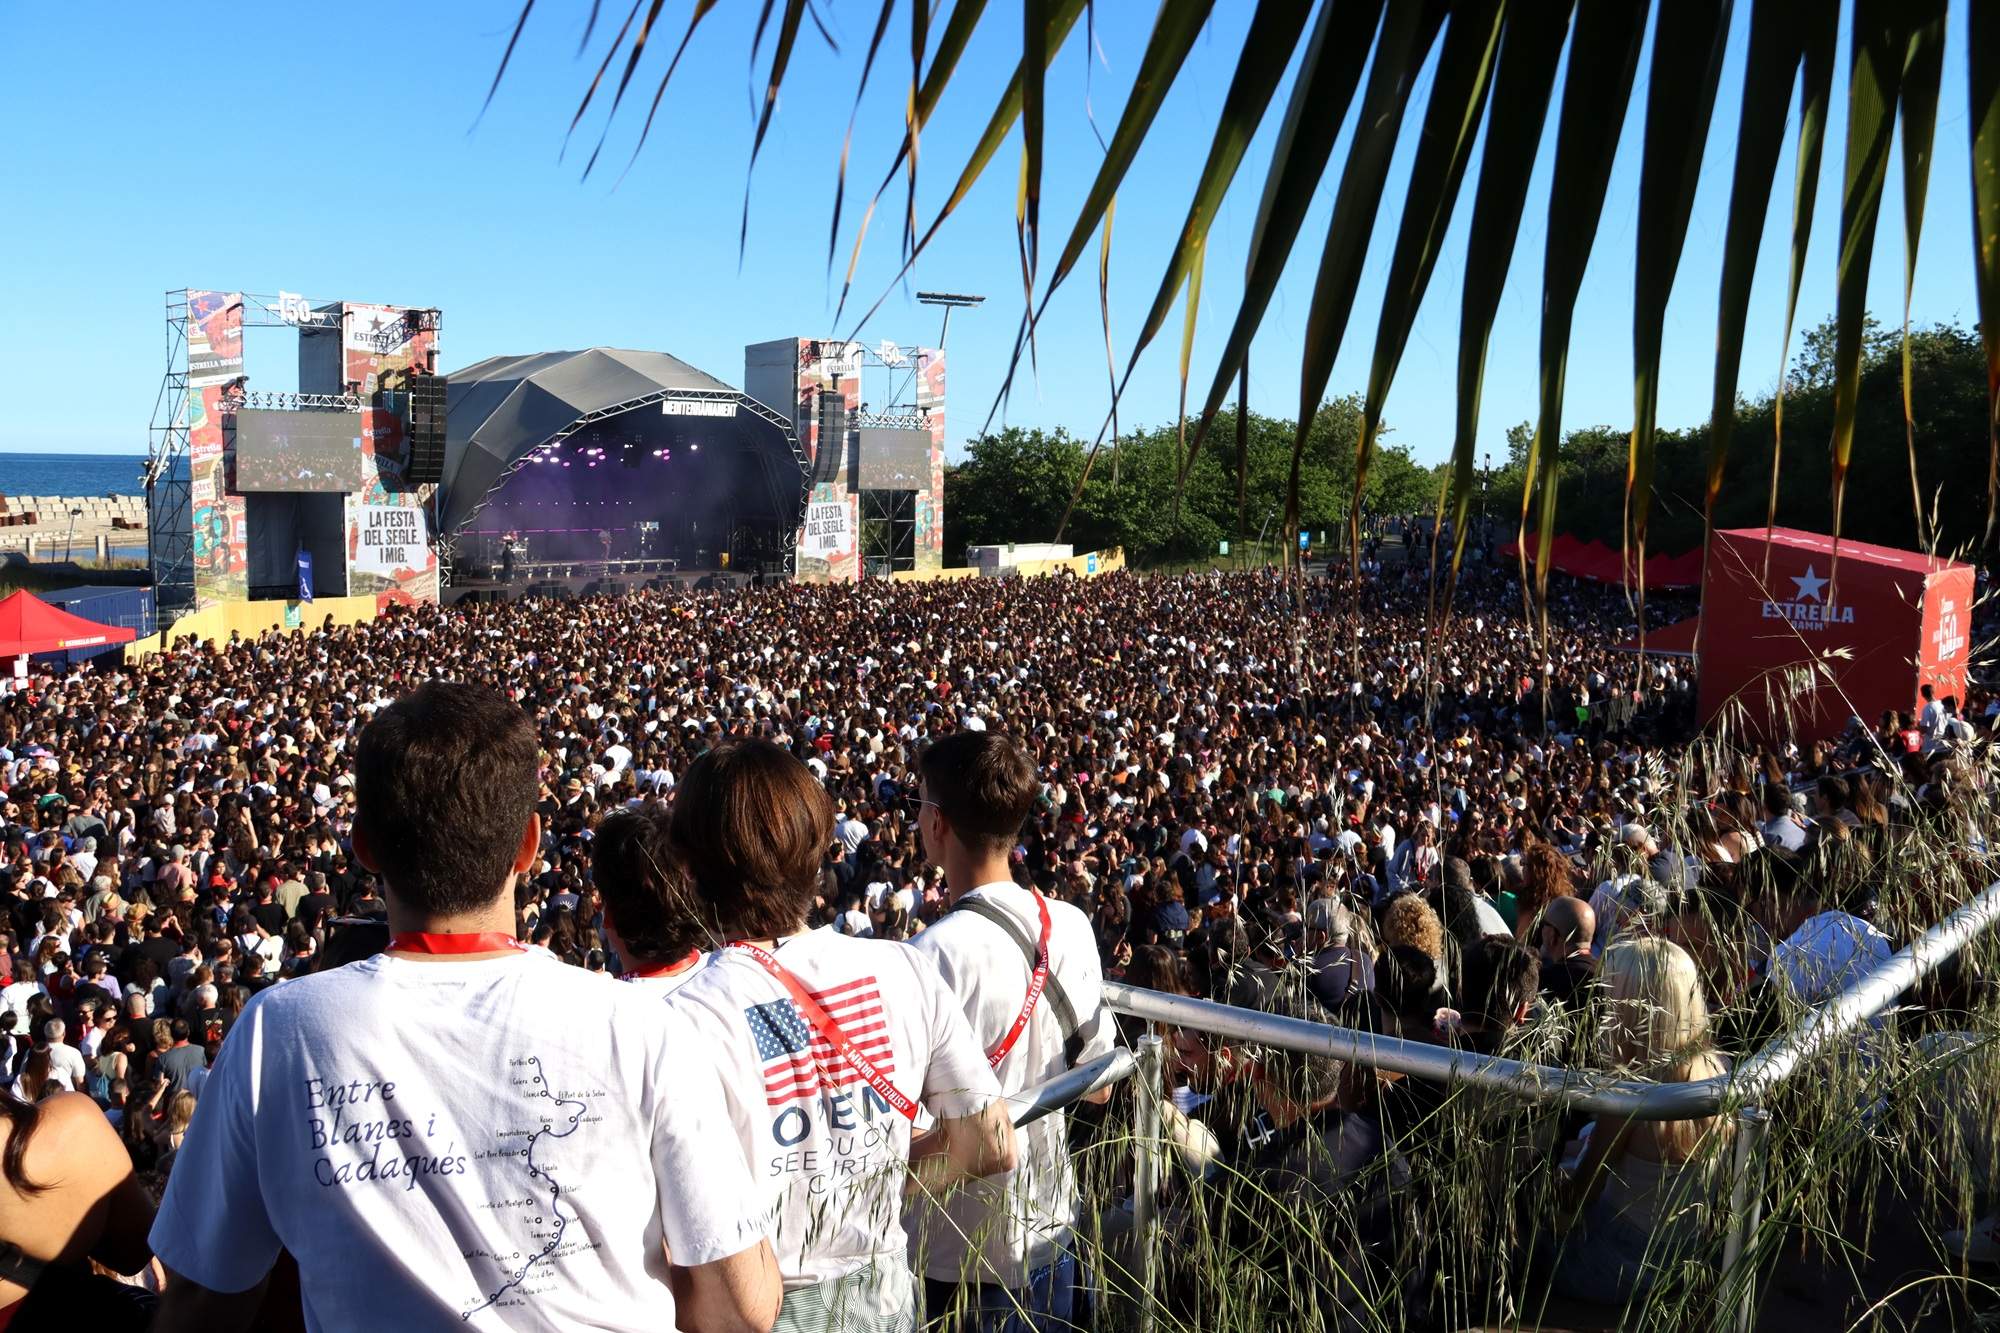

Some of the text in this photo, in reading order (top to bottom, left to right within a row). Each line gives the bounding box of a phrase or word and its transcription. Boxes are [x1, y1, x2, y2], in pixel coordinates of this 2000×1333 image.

[279, 289, 311, 323] 150
[369, 511, 415, 528] LA FESTA
[810, 505, 842, 521] LA FESTA
[364, 529, 420, 546] DEL SEGLE.
[808, 519, 846, 536] DEL SEGLE.
[823, 535, 838, 549] MIG.
[380, 547, 408, 563] I MIG.
[1762, 600, 1855, 623] ESTRELLA
[1792, 620, 1823, 631] DAMM
[740, 944, 773, 965] DAMM
[1022, 974, 1045, 1018] ESTRELLA
[847, 1049, 907, 1108] ESTRELLA DAMM
[305, 1078, 396, 1110] Entre
[308, 1105, 436, 1150] Blanes i
[314, 1141, 467, 1191] Cadaqués
[770, 1151, 818, 1177] SEE
